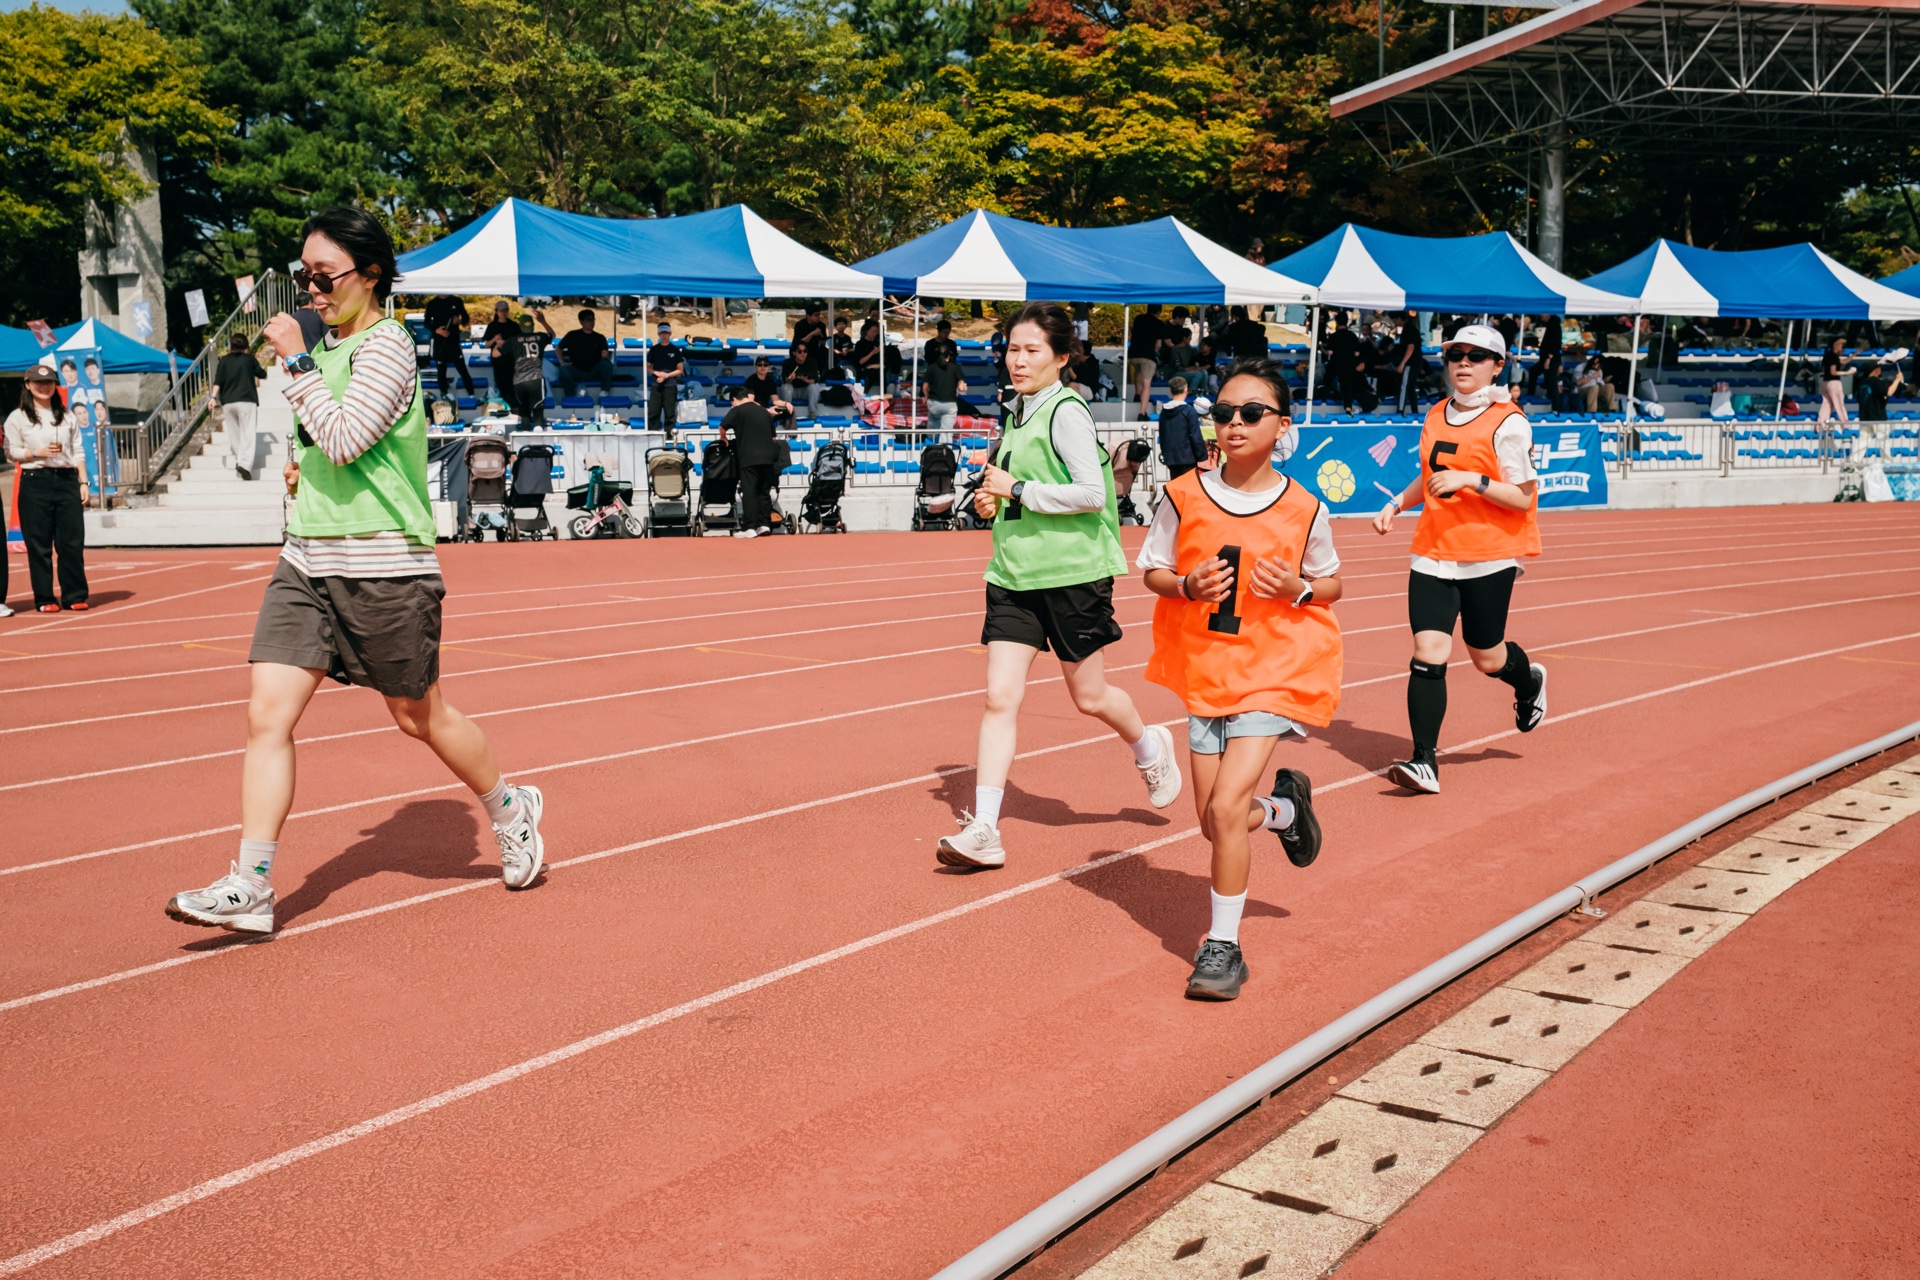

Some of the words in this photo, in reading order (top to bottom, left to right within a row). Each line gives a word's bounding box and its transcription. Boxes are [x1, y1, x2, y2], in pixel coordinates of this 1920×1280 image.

[522, 342, 540, 359] 19
[1428, 440, 1460, 499] 5
[1207, 544, 1242, 635] 1
[519, 829, 530, 844] N
[972, 831, 989, 845] N
[226, 892, 241, 906] N
